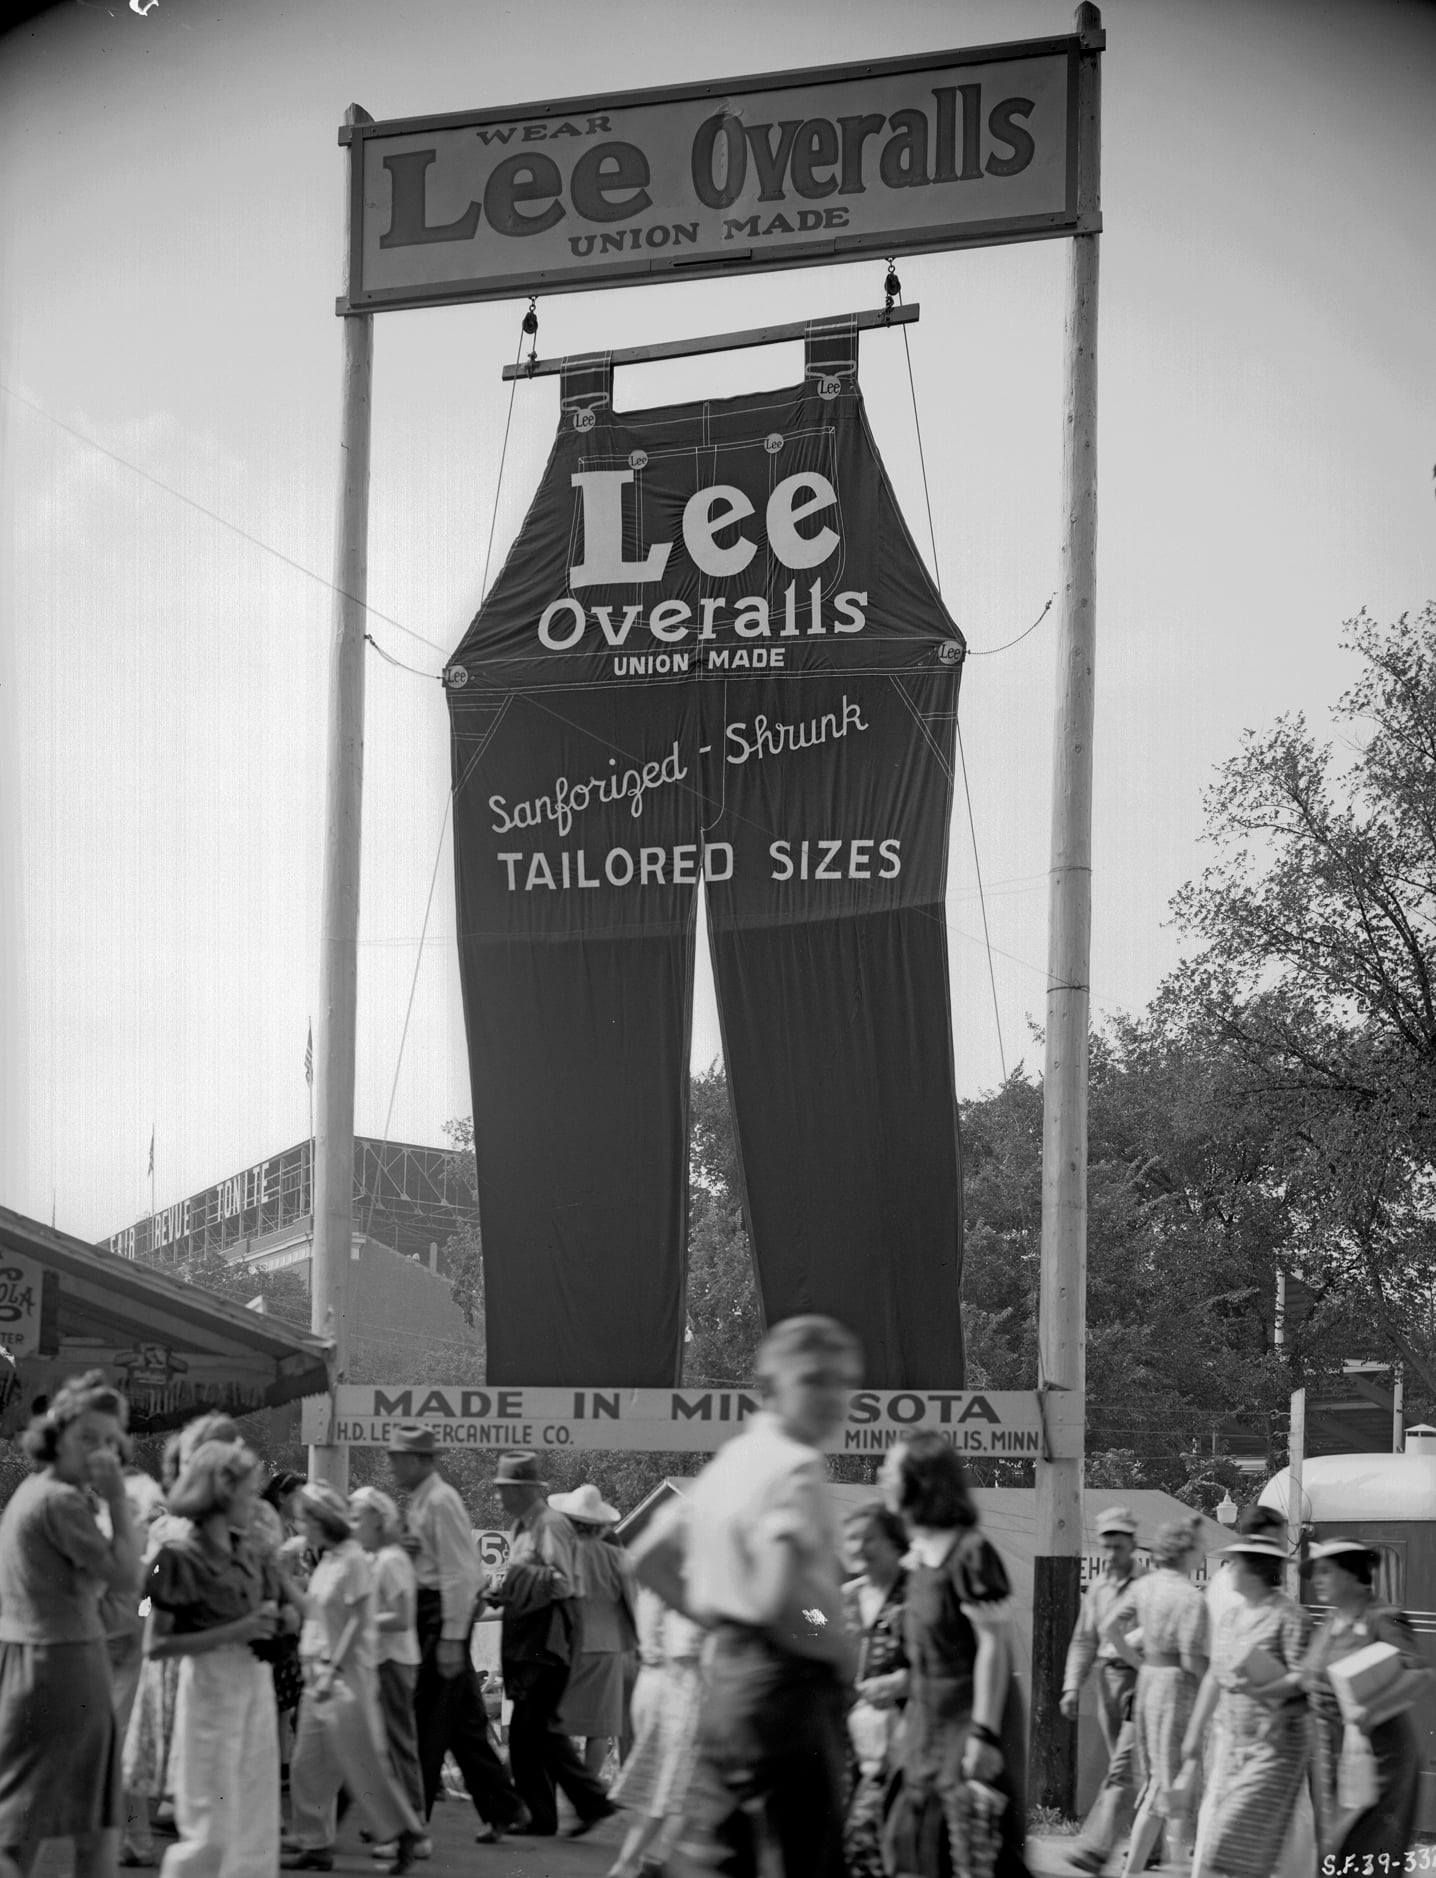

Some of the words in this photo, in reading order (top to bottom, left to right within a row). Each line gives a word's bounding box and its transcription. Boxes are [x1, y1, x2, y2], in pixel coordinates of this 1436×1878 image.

[476, 116, 612, 146] WEAR
[379, 141, 654, 250] Lee
[691, 83, 1036, 210] Overalls
[568, 222, 700, 257] UNION
[723, 206, 850, 241] MADE
[819, 381, 841, 395] Lee
[575, 412, 595, 427] Lee
[764, 438, 784, 450] Lee
[629, 455, 648, 466] Lee
[569, 470, 840, 588] Lee
[537, 577, 868, 650] Overalls
[613, 653, 689, 676] UNION
[708, 647, 785, 670] MADE
[940, 643, 961, 659] Lee
[447, 669, 466, 683] Lee
[488, 741, 688, 837] Sanforized
[726, 695, 869, 764] Shrunk
[498, 842, 734, 891] TAILORED
[769, 839, 902, 881] SIZES
[153, 1200, 191, 1250] REVUE
[216, 1161, 270, 1222] TONITE
[373, 1389, 523, 1419] MADE
[573, 1391, 621, 1420] IN
[671, 1392, 1002, 1425] MINSOTA
[336, 1421, 367, 1442] H.D.
[370, 1421, 402, 1443] LE
[412, 1423, 533, 1445] ERCANTILE
[542, 1424, 574, 1446] CO.
